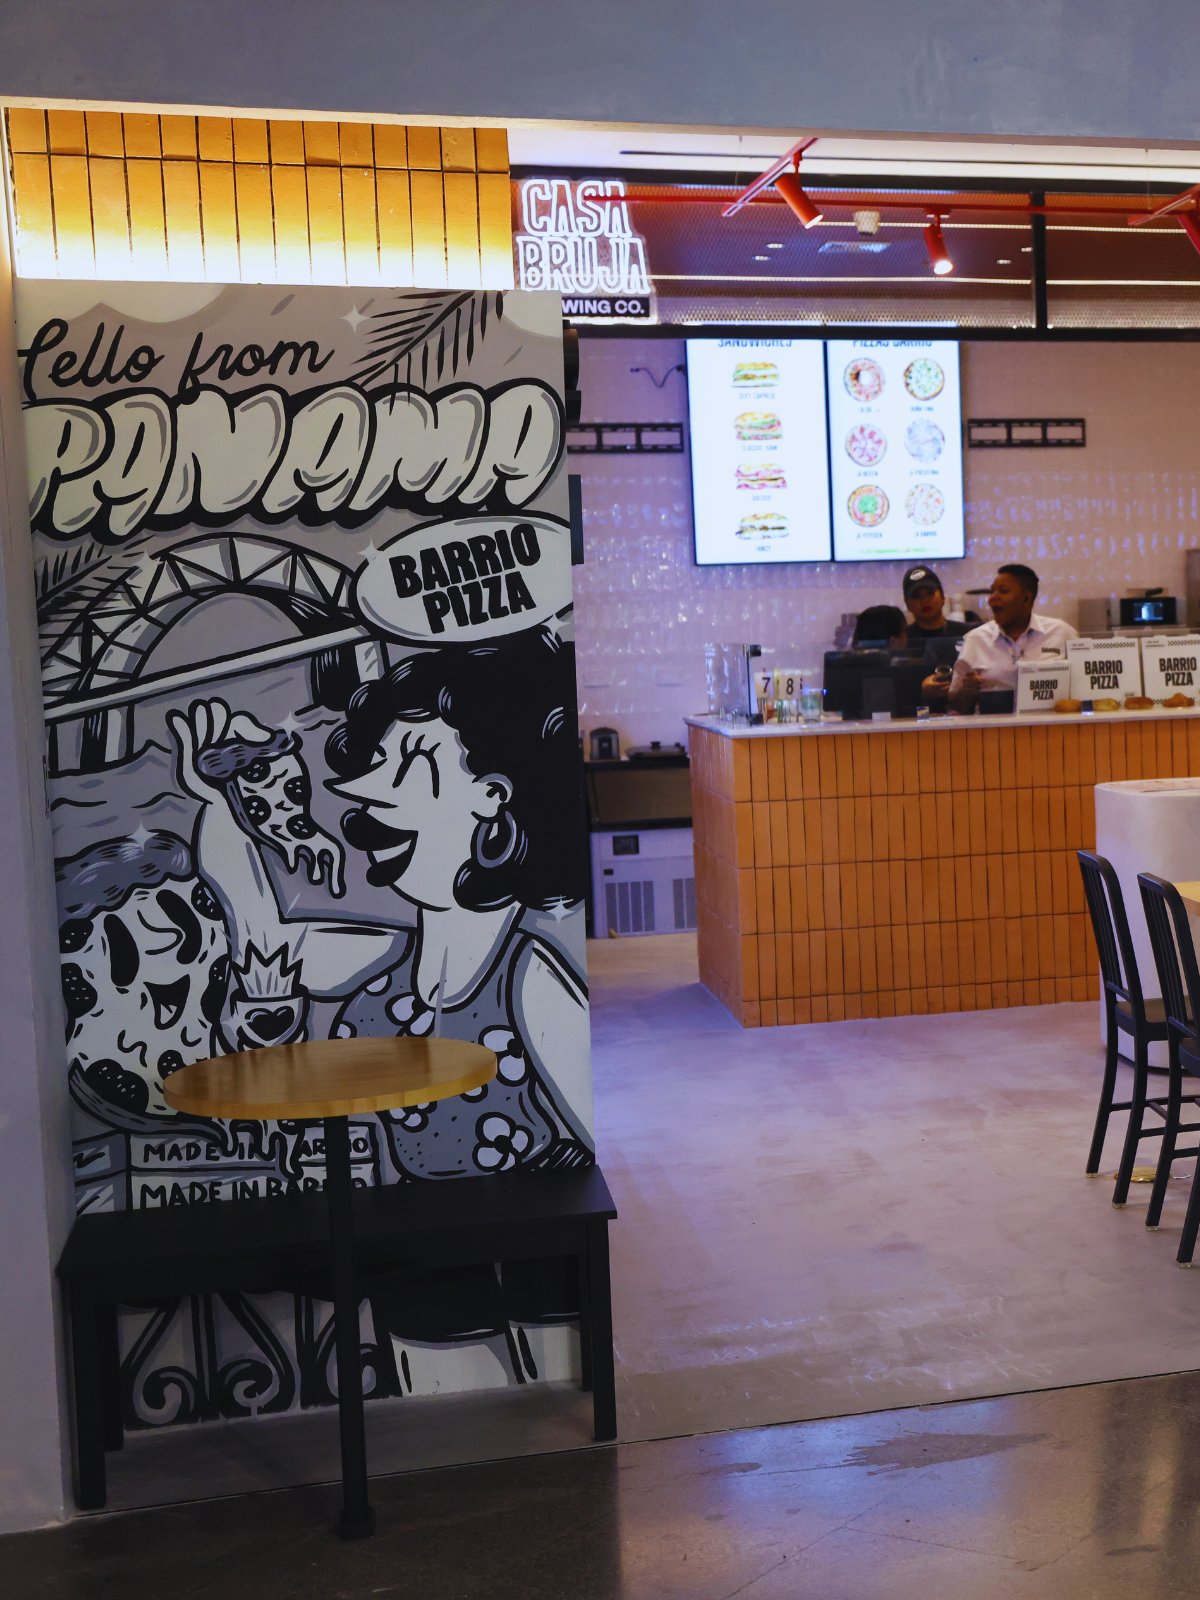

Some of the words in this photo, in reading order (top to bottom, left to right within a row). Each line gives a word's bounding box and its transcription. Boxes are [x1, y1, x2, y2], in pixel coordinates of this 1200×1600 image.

[521, 178, 633, 237] CASA
[516, 236, 651, 294] BRUJA
[614, 299, 645, 314] CO.
[178, 332, 336, 404] from
[20, 378, 567, 546] PANAMA
[388, 522, 541, 600] BARRIO
[422, 574, 538, 635] PIZZA
[1084, 660, 1123, 675] BARRIO
[1159, 656, 1197, 673] BARRIO
[762, 677, 771, 693] 7
[786, 677, 794, 695] 8
[1029, 679, 1058, 691] BARRIO
[1090, 675, 1119, 690] PIZZA
[1165, 672, 1193, 687] PIZZA
[1032, 690, 1054, 700] PIZZA
[143, 1143, 221, 1163] MADE
[140, 1180, 223, 1210] MADE
[232, 1179, 260, 1199] IN
